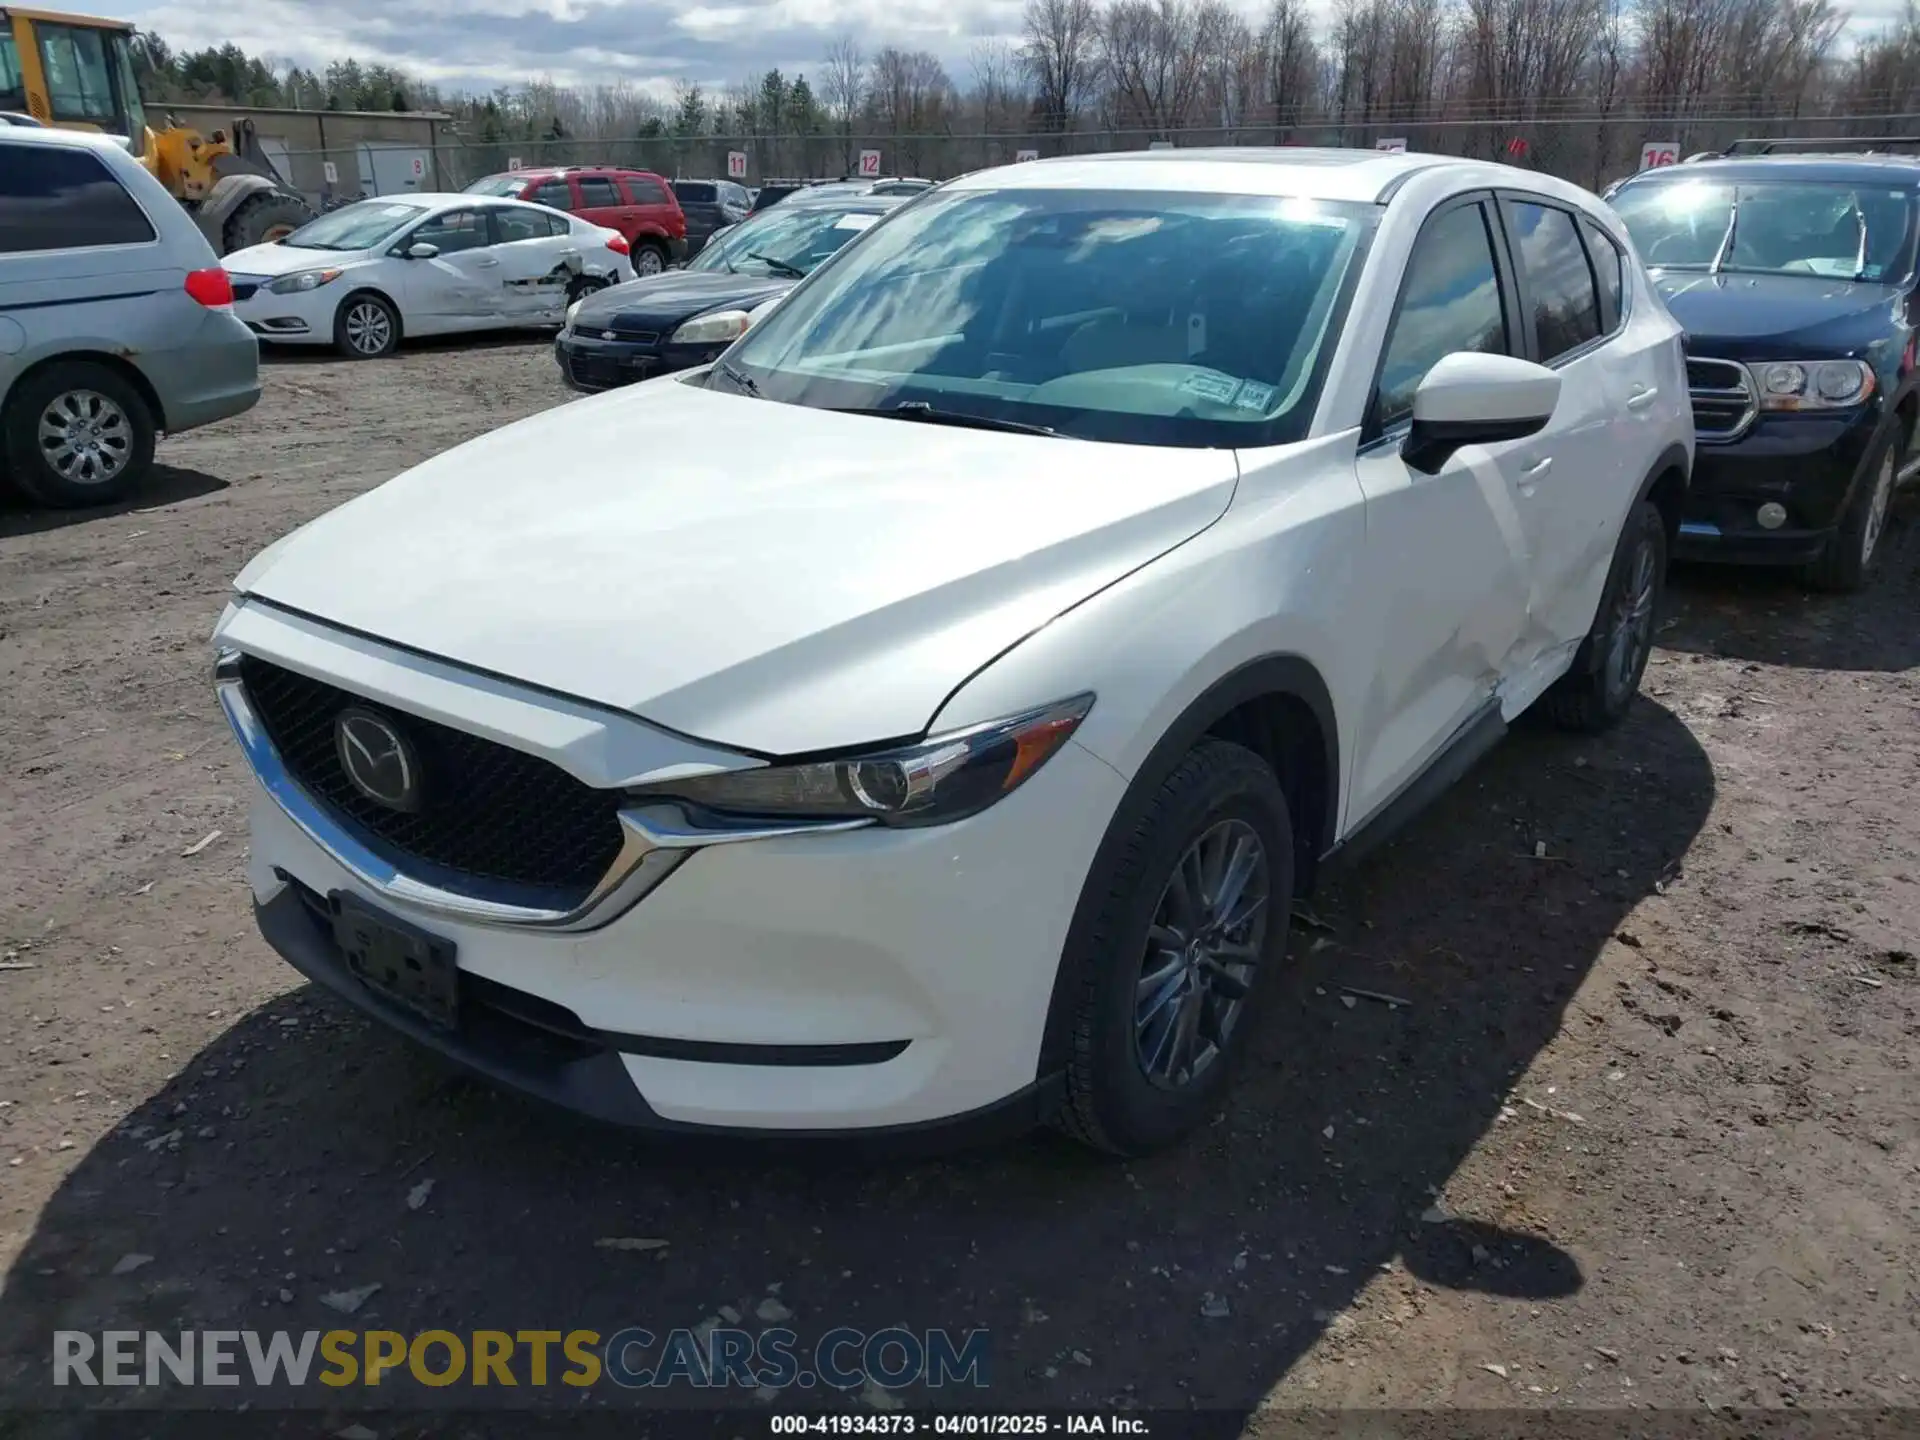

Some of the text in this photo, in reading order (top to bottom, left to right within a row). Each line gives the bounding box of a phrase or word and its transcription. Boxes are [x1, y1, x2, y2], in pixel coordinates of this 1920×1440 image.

[413, 159, 422, 174] 8
[730, 157, 744, 173] 11
[862, 155, 878, 172] 12
[1645, 150, 1674, 168] 16
